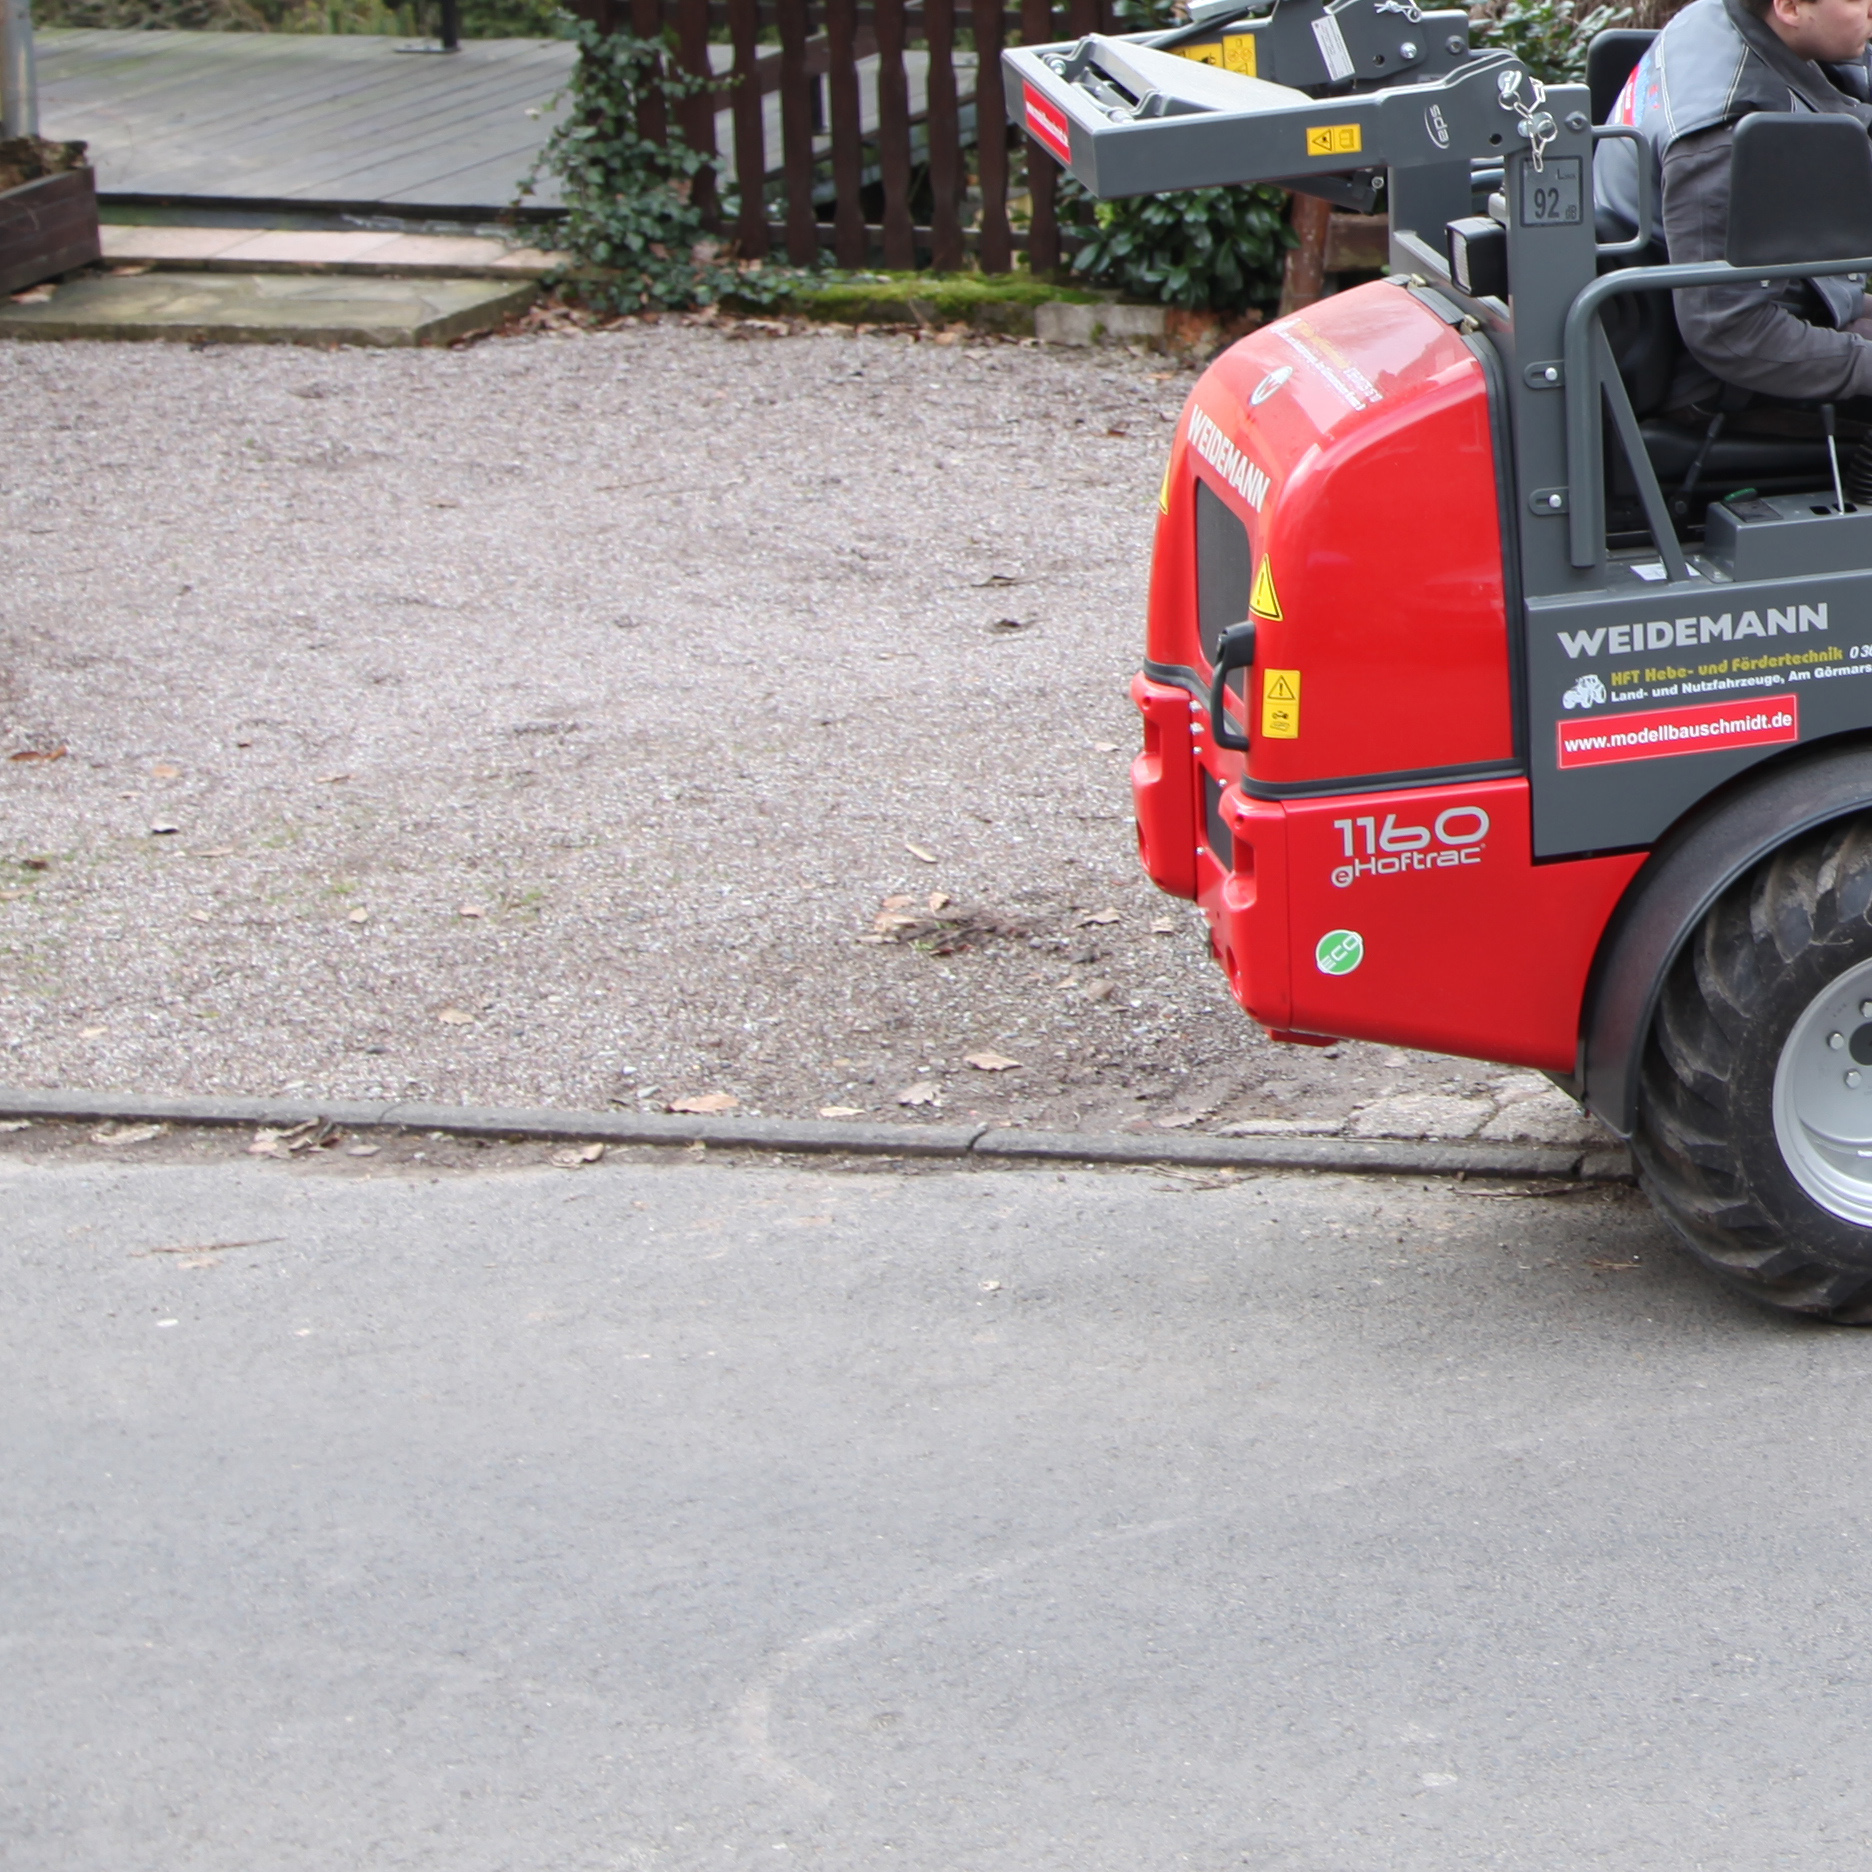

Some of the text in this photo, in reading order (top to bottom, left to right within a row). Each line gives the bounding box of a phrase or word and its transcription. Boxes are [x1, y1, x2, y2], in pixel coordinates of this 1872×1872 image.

[1534, 187, 1560, 219] 92
[1187, 402, 1271, 514] WEIDEMANN
[1556, 602, 1829, 659] WEIDEMANN
[1610, 669, 1641, 687] HFT
[1644, 665, 1694, 683] Hebe-
[1697, 660, 1729, 676] und
[1731, 645, 1844, 672] Fördertechnik
[1610, 688, 1649, 703] Land-
[1651, 684, 1679, 698] und
[1681, 674, 1785, 695] Nutzfahrzeuge,
[1787, 670, 1811, 683] Am
[1563, 711, 1793, 753] www.modellbauschmidt.de
[1333, 805, 1490, 858] 1160
[1319, 934, 1361, 972] ECO
